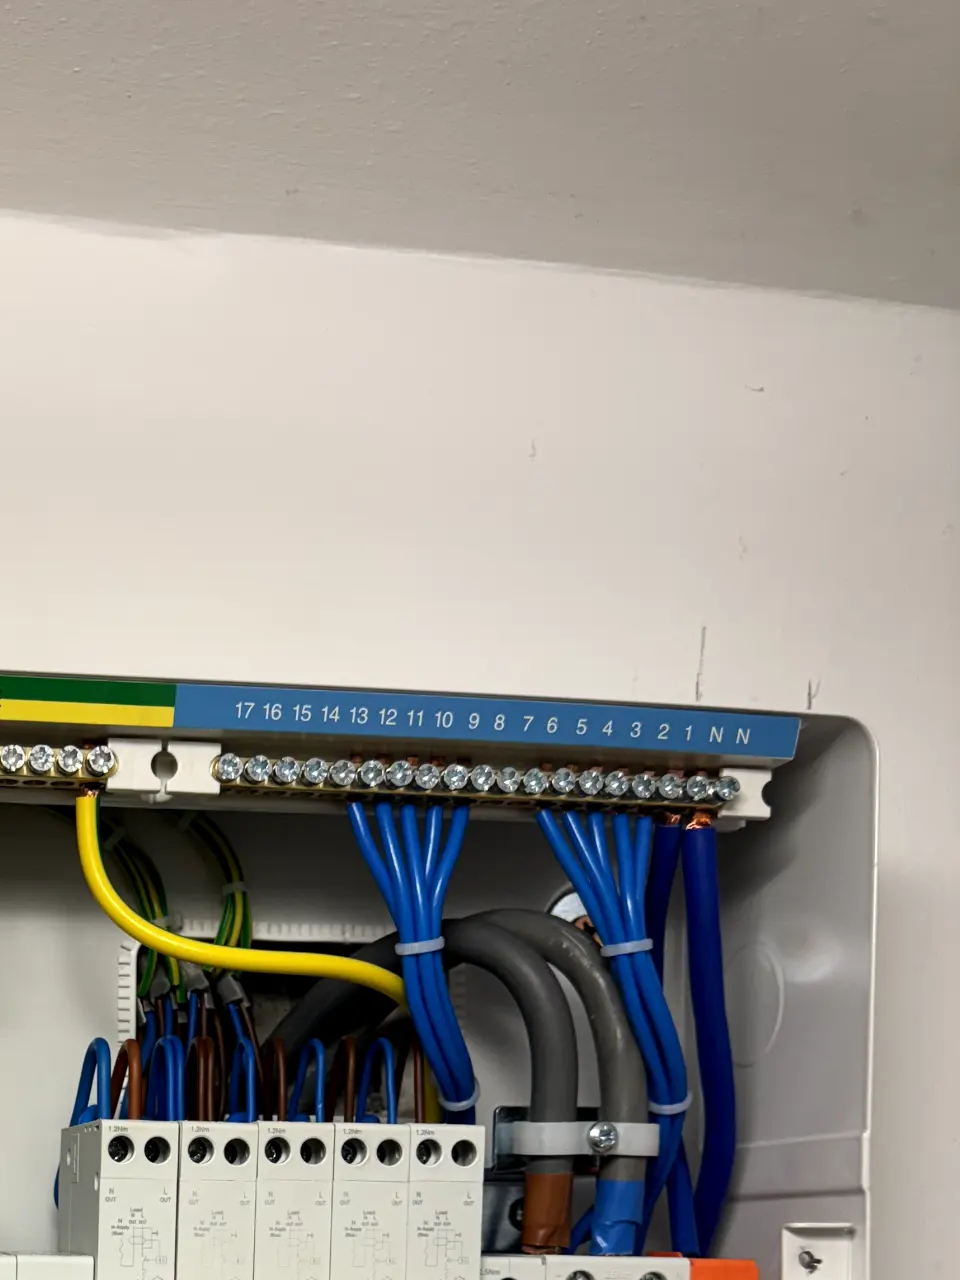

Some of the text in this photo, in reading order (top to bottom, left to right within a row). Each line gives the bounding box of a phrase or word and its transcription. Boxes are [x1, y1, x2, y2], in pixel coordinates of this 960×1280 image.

[235, 701, 750, 745] 17 16 15 14 13 12 11 10 9 8 7 6 5 4 3 2 1 N N
